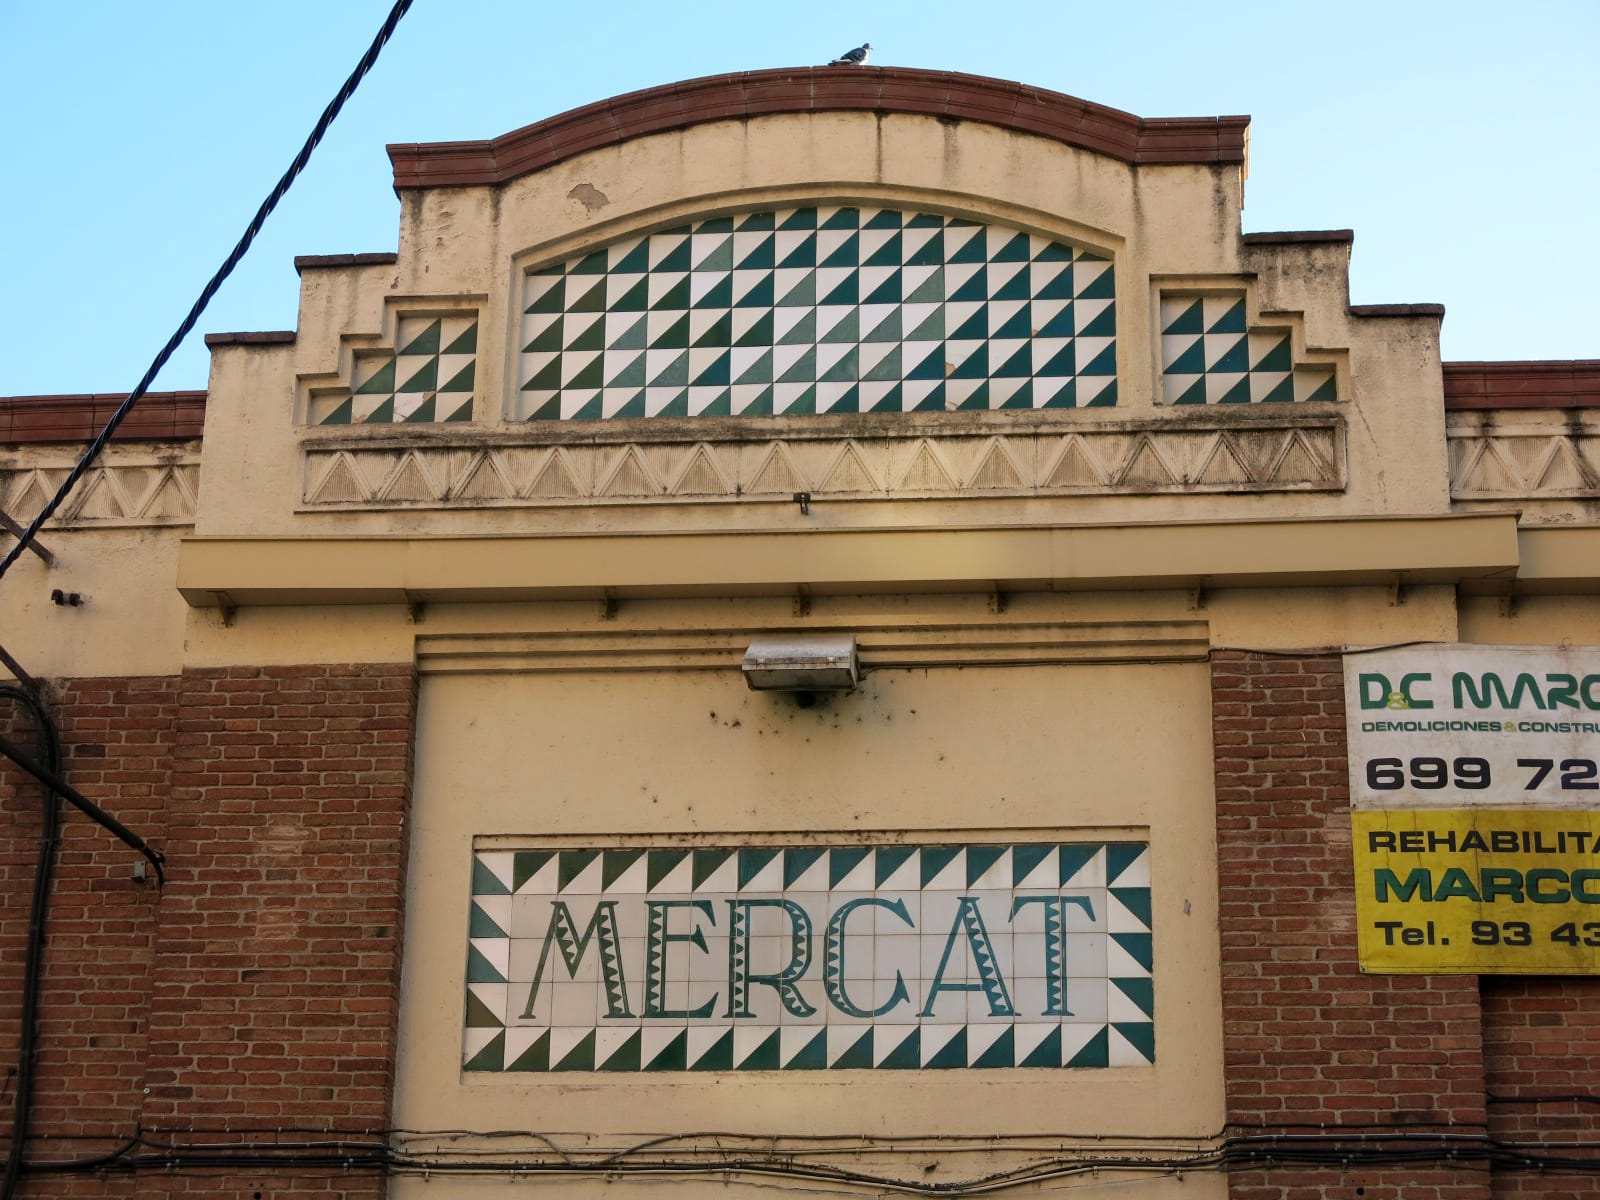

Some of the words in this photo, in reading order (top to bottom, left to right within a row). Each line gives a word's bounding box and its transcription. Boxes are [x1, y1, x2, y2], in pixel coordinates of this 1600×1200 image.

[1366, 757, 1491, 790] 699
[1517, 758, 1600, 790] 72
[1368, 830, 1600, 854] REHABILIT
[1374, 921, 1449, 946] Tel.
[1471, 920, 1532, 946] 93
[518, 896, 1097, 1019] MERCAT
